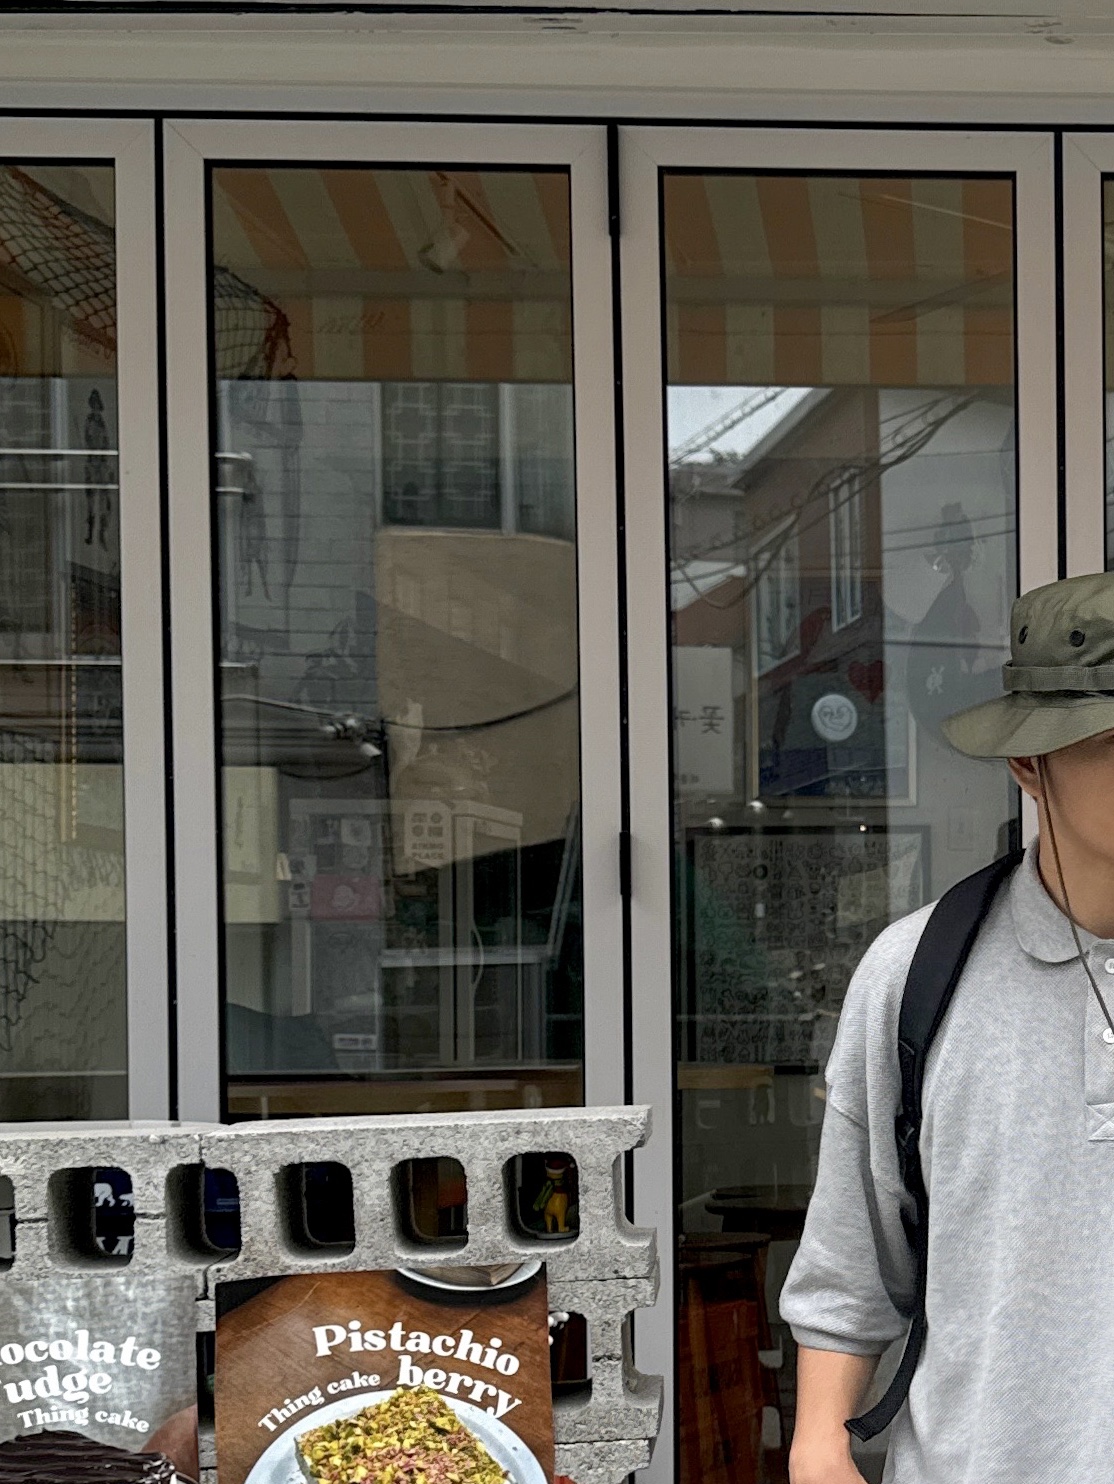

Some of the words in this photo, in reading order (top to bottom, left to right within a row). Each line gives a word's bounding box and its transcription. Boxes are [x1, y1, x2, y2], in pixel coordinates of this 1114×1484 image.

[0, 1329, 161, 1370] ocolate
[312, 1320, 520, 1376] Pistachio
[0, 1365, 112, 1404] udge
[257, 1385, 325, 1433] Thing
[326, 1371, 380, 1395] cake
[396, 1355, 522, 1419] berry
[17, 1405, 89, 1429] Thing
[95, 1410, 150, 1432] cake
